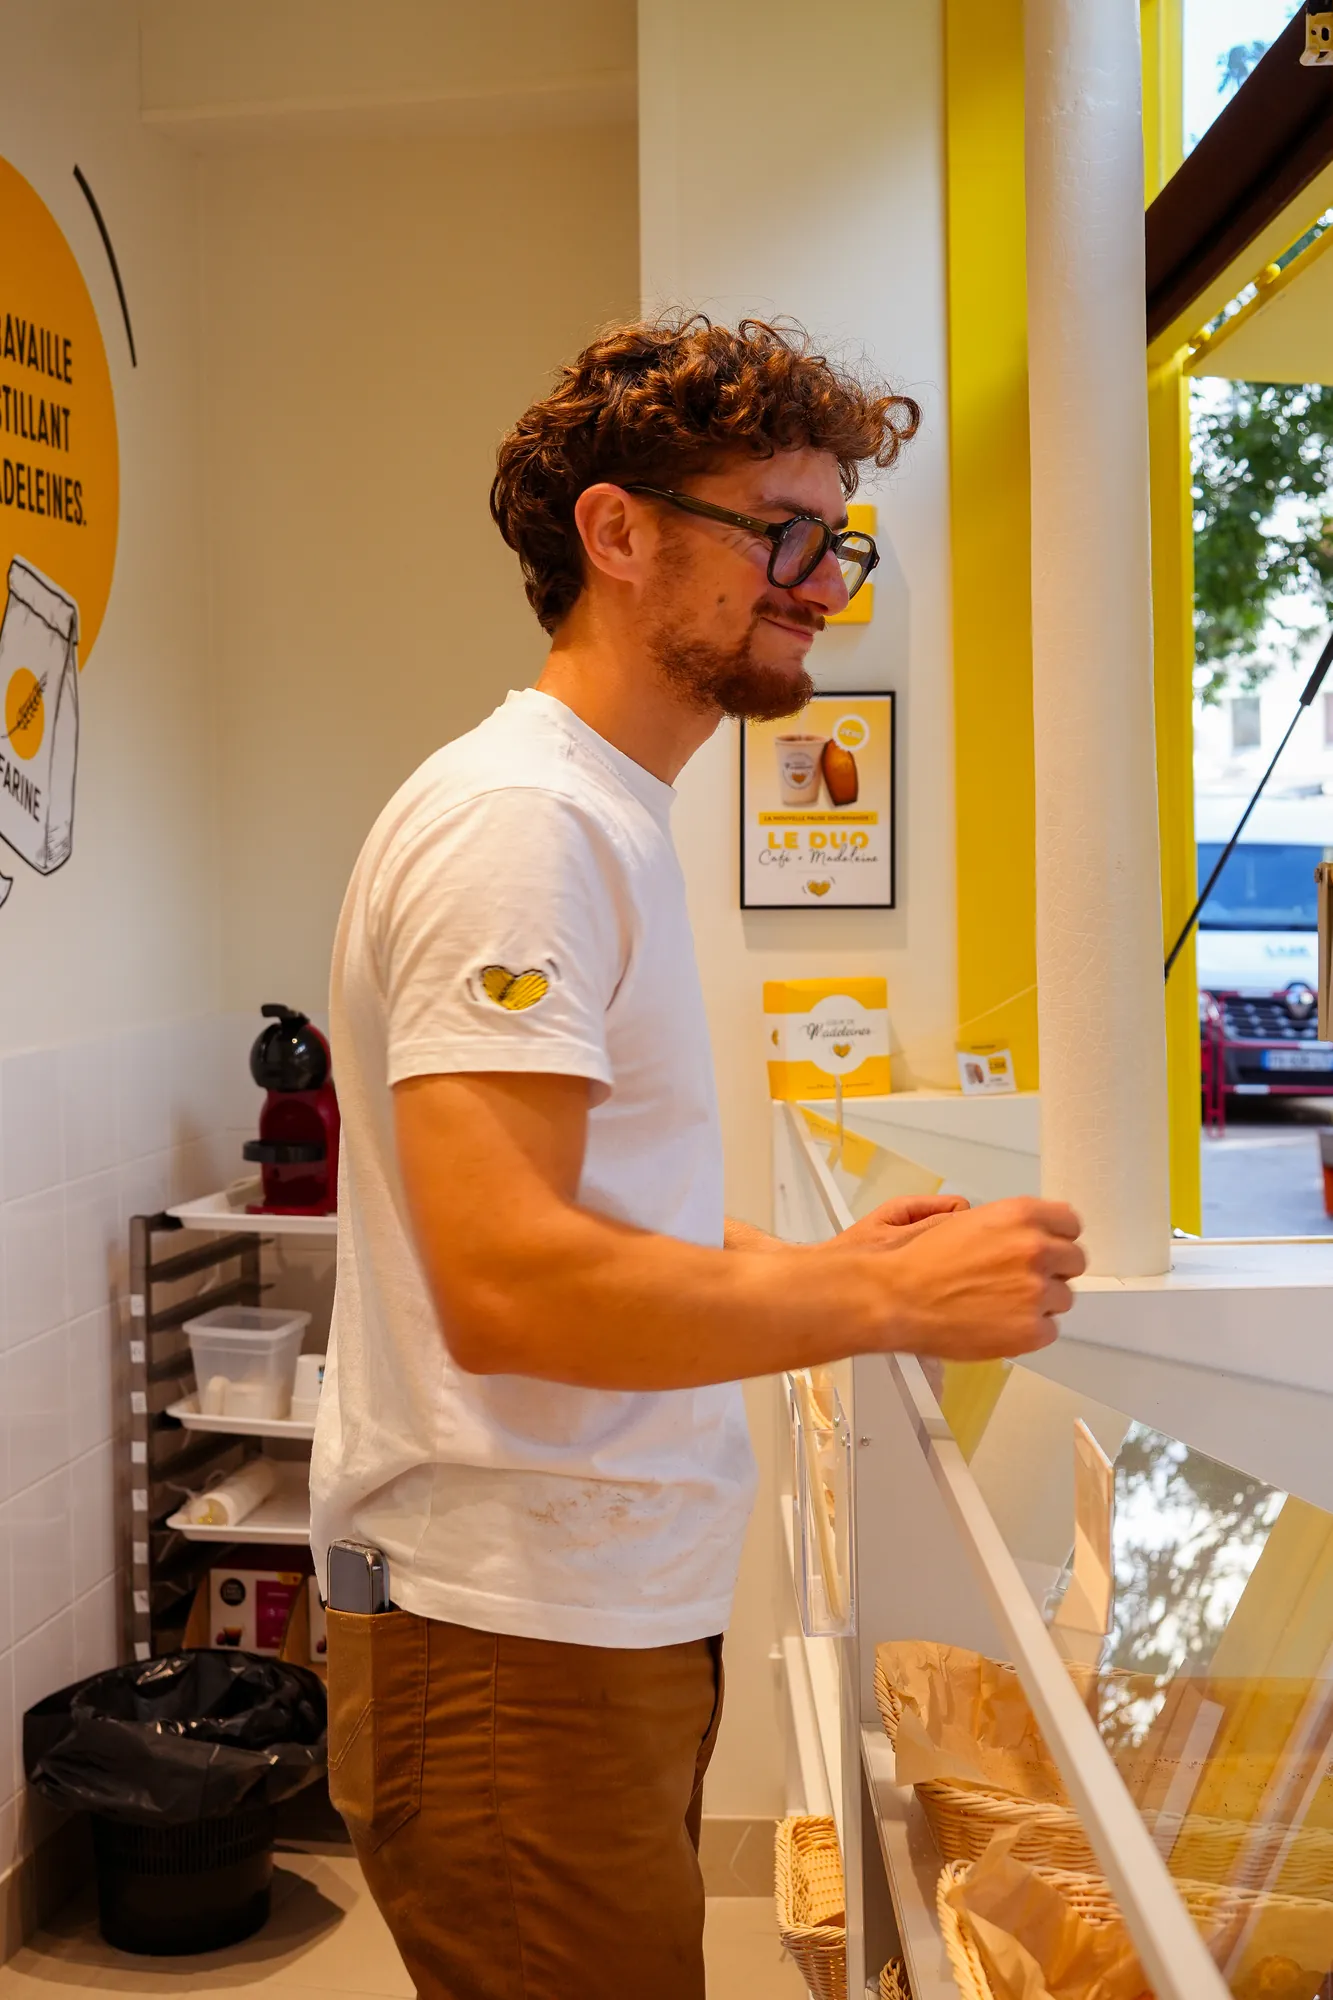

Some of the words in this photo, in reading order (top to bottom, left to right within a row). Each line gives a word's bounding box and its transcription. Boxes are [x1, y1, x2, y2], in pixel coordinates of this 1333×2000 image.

[0, 313, 73, 385] AVAILLE
[0, 458, 87, 527] DELEINES.
[768, 831, 800, 850] LE
[809, 831, 870, 850] DUO
[809, 843, 879, 866] Madeleine
